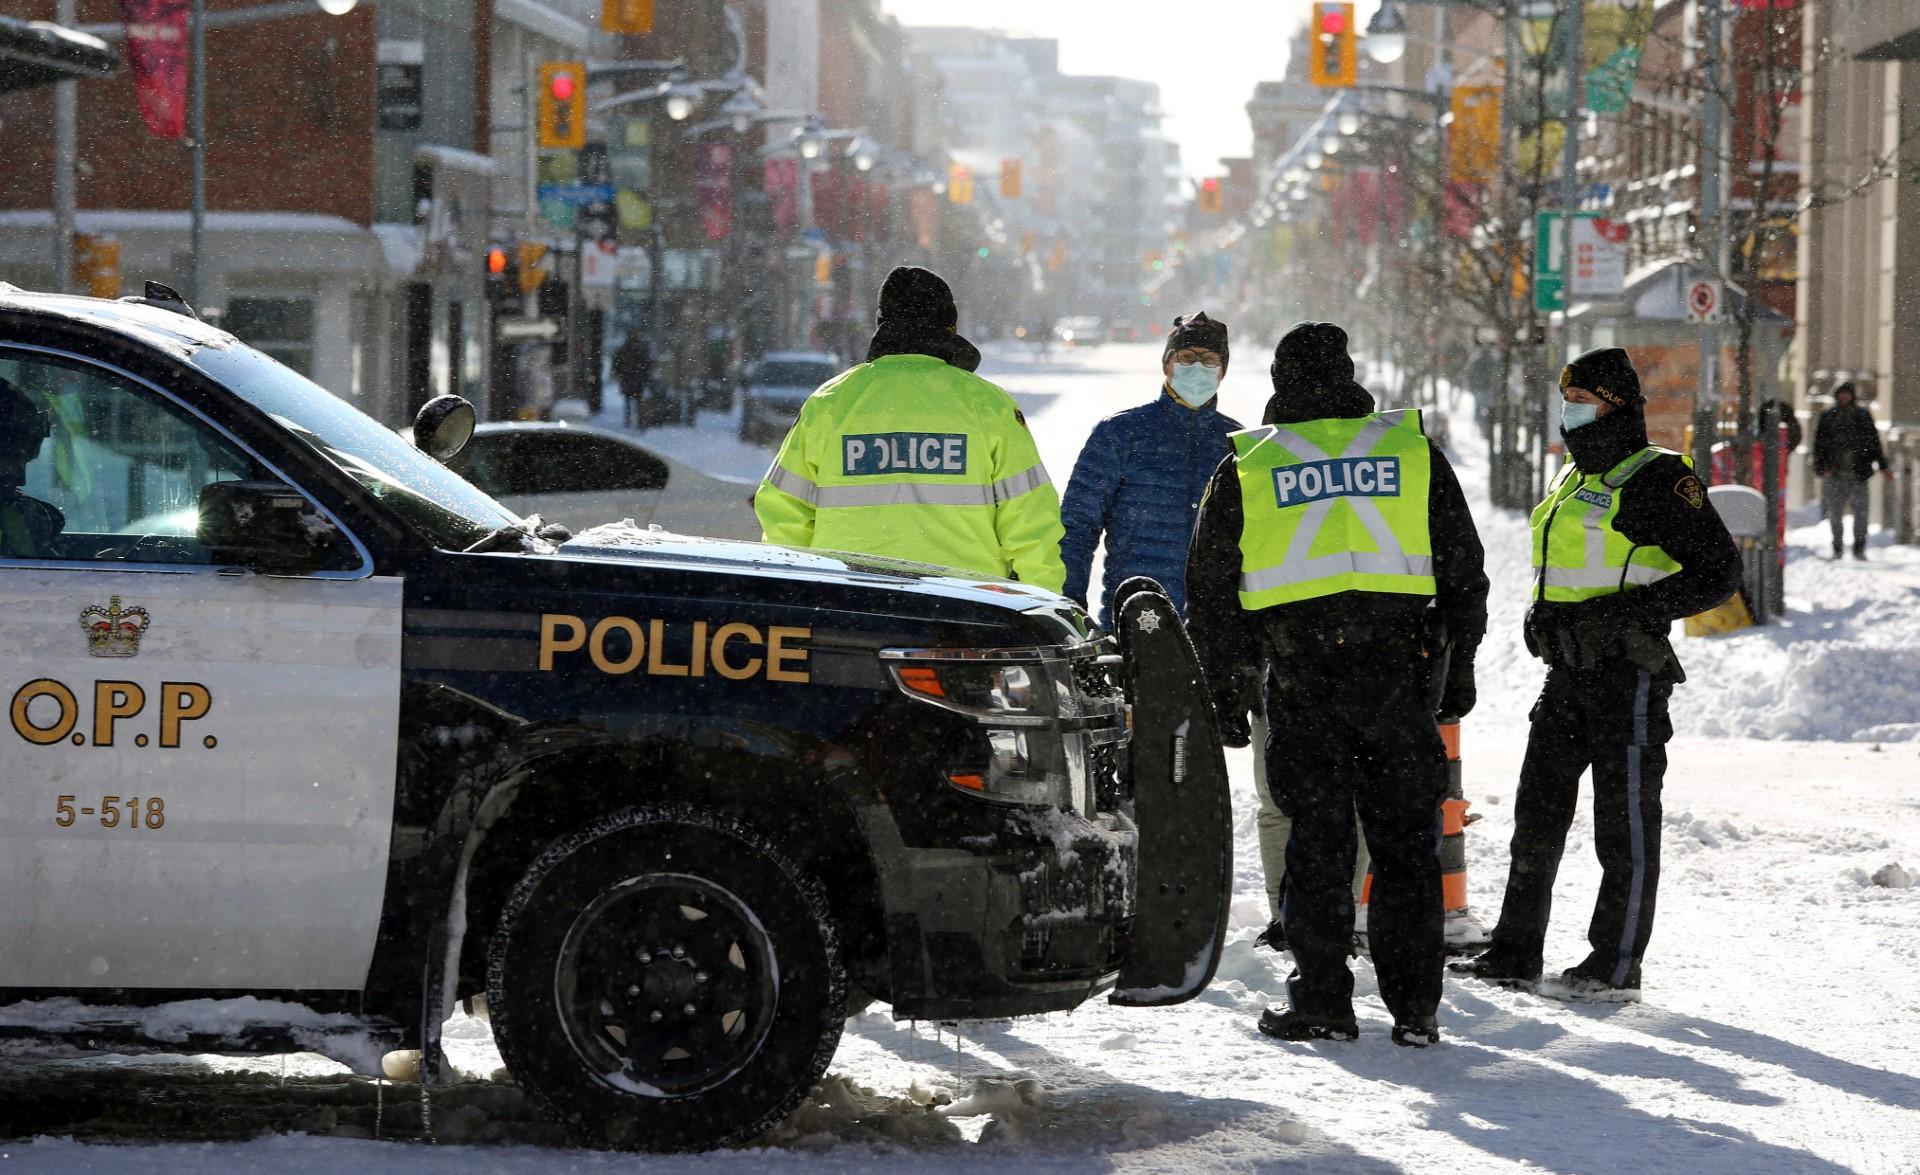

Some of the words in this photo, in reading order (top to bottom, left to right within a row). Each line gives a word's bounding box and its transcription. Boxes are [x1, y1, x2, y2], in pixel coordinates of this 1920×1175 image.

[1276, 460, 1396, 502] POLICE
[1577, 489, 1611, 506] POLICE
[538, 613, 812, 683] POLICE
[9, 677, 218, 749] O.P.P.
[55, 795, 166, 830] 5-518
